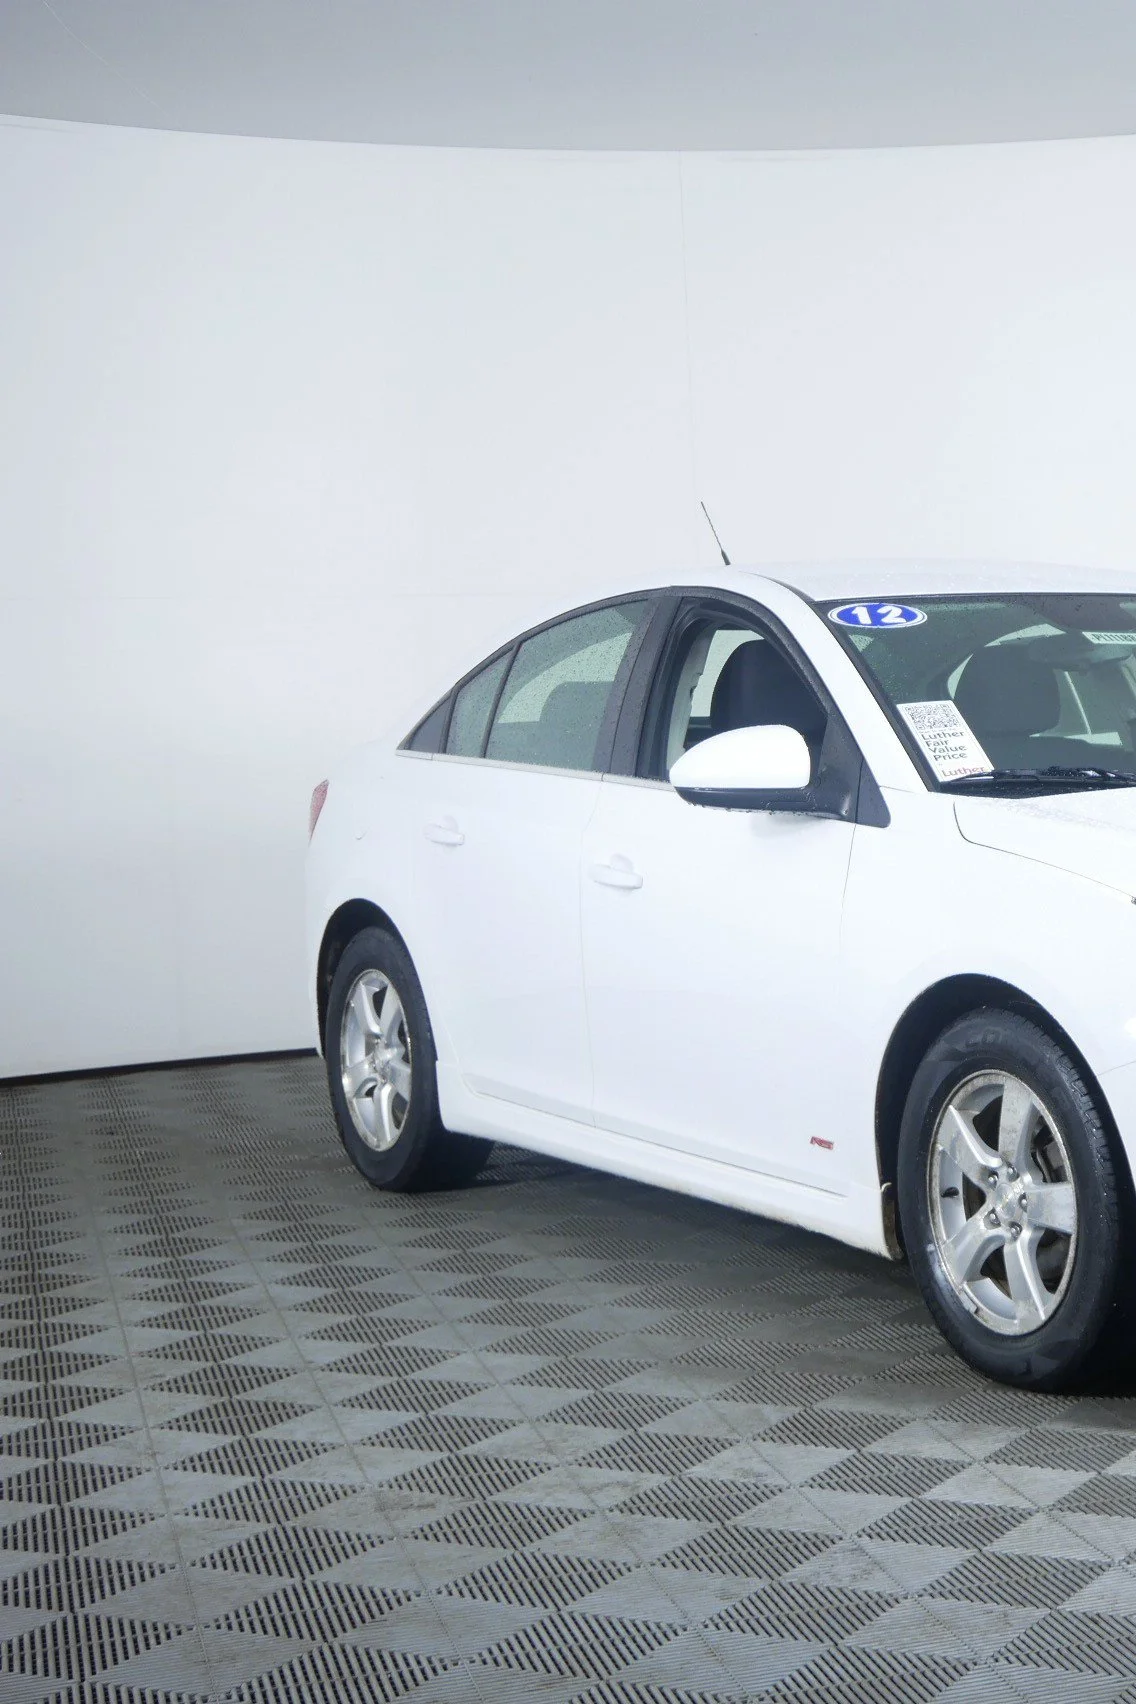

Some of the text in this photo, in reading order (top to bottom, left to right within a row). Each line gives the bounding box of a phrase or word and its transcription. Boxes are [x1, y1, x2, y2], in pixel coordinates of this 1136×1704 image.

[852, 605, 907, 625] 12
[921, 731, 965, 741] Luther
[925, 740, 949, 748] Fair
[929, 745, 968, 754] Value
[933, 752, 968, 761] Price
[942, 766, 985, 777] Luther
